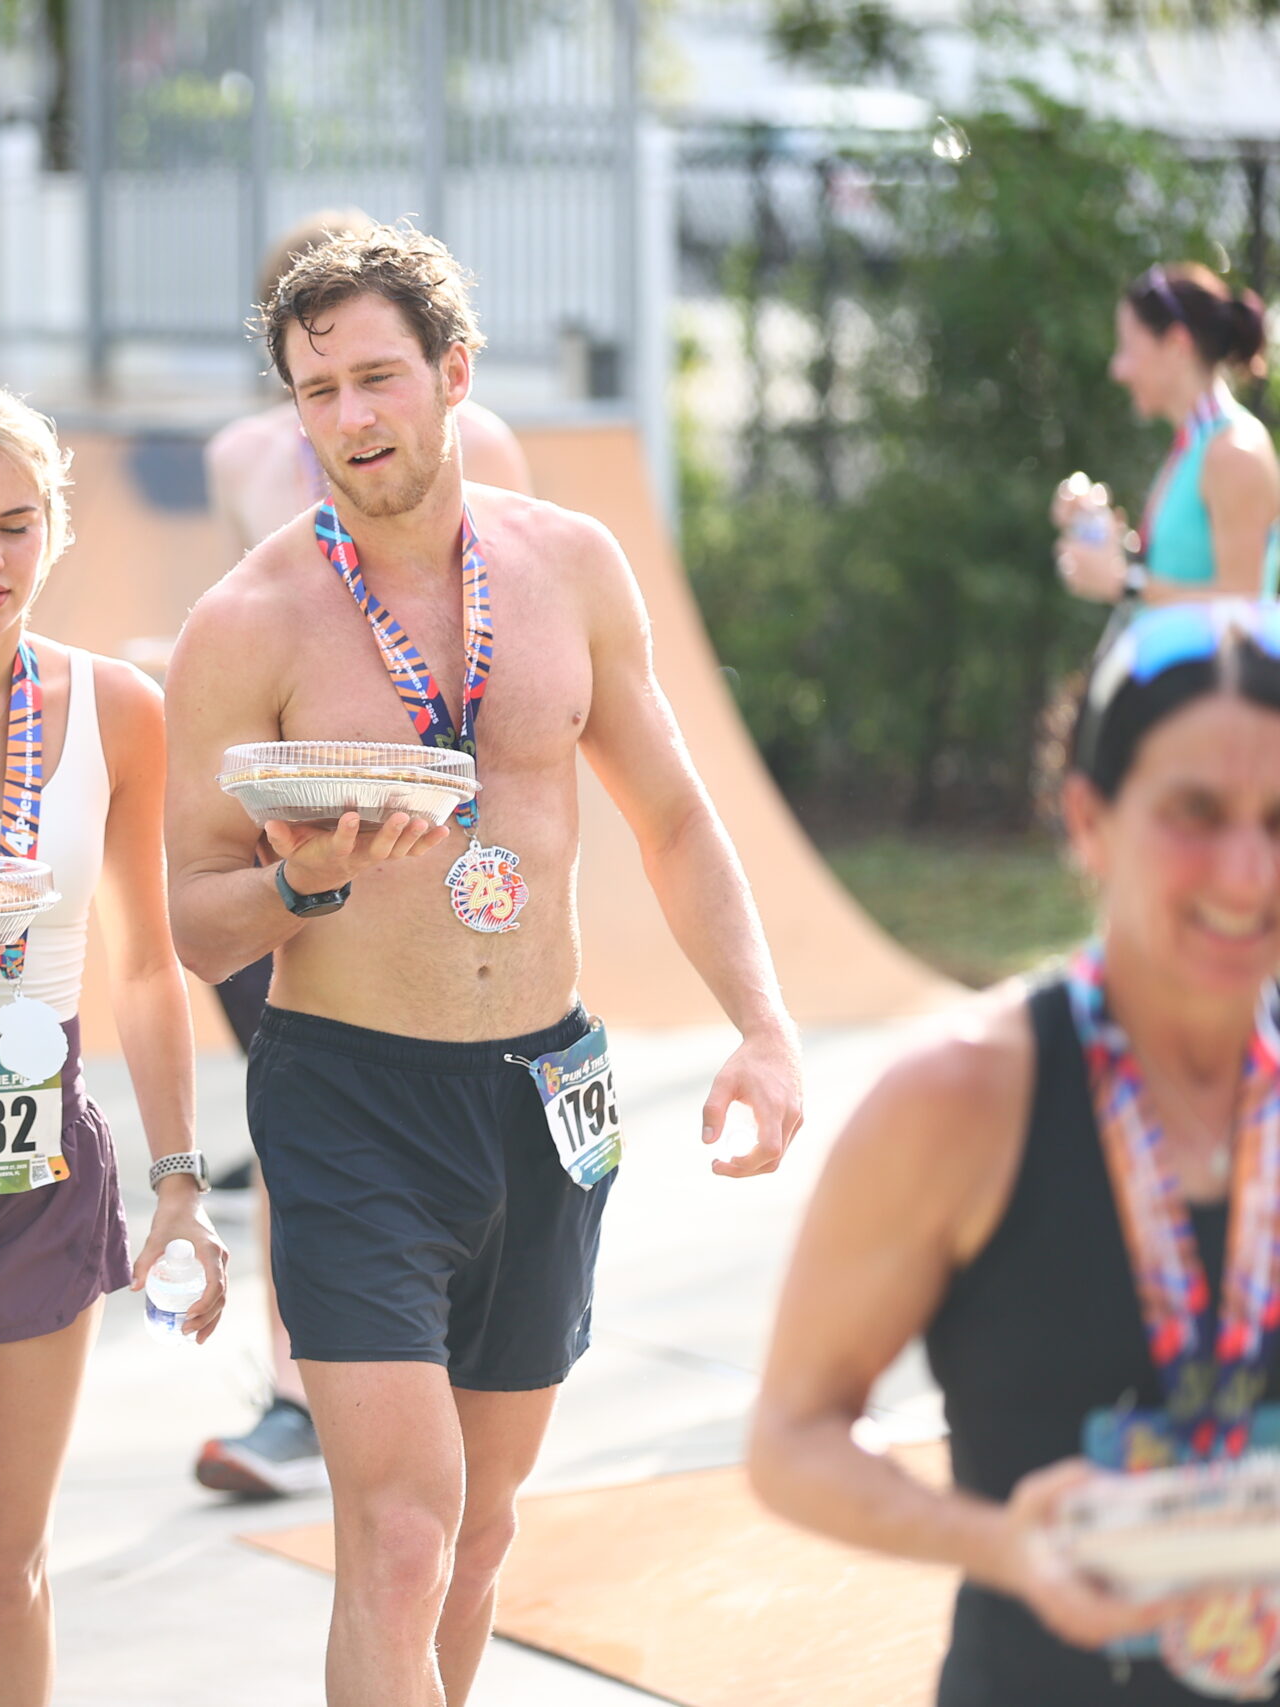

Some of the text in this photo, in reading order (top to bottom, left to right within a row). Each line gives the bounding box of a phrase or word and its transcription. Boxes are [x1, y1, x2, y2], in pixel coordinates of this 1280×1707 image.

[393, 648, 423, 691] NOVEMBER
[425, 702, 440, 725] 2025
[24, 742, 33, 789] PRESENTED
[16, 790, 32, 833] Pies
[5, 830, 34, 856] 4
[448, 861, 467, 886] RUN
[478, 850, 492, 858] THE
[494, 848, 518, 866] PIES
[562, 1068, 582, 1084] RUN
